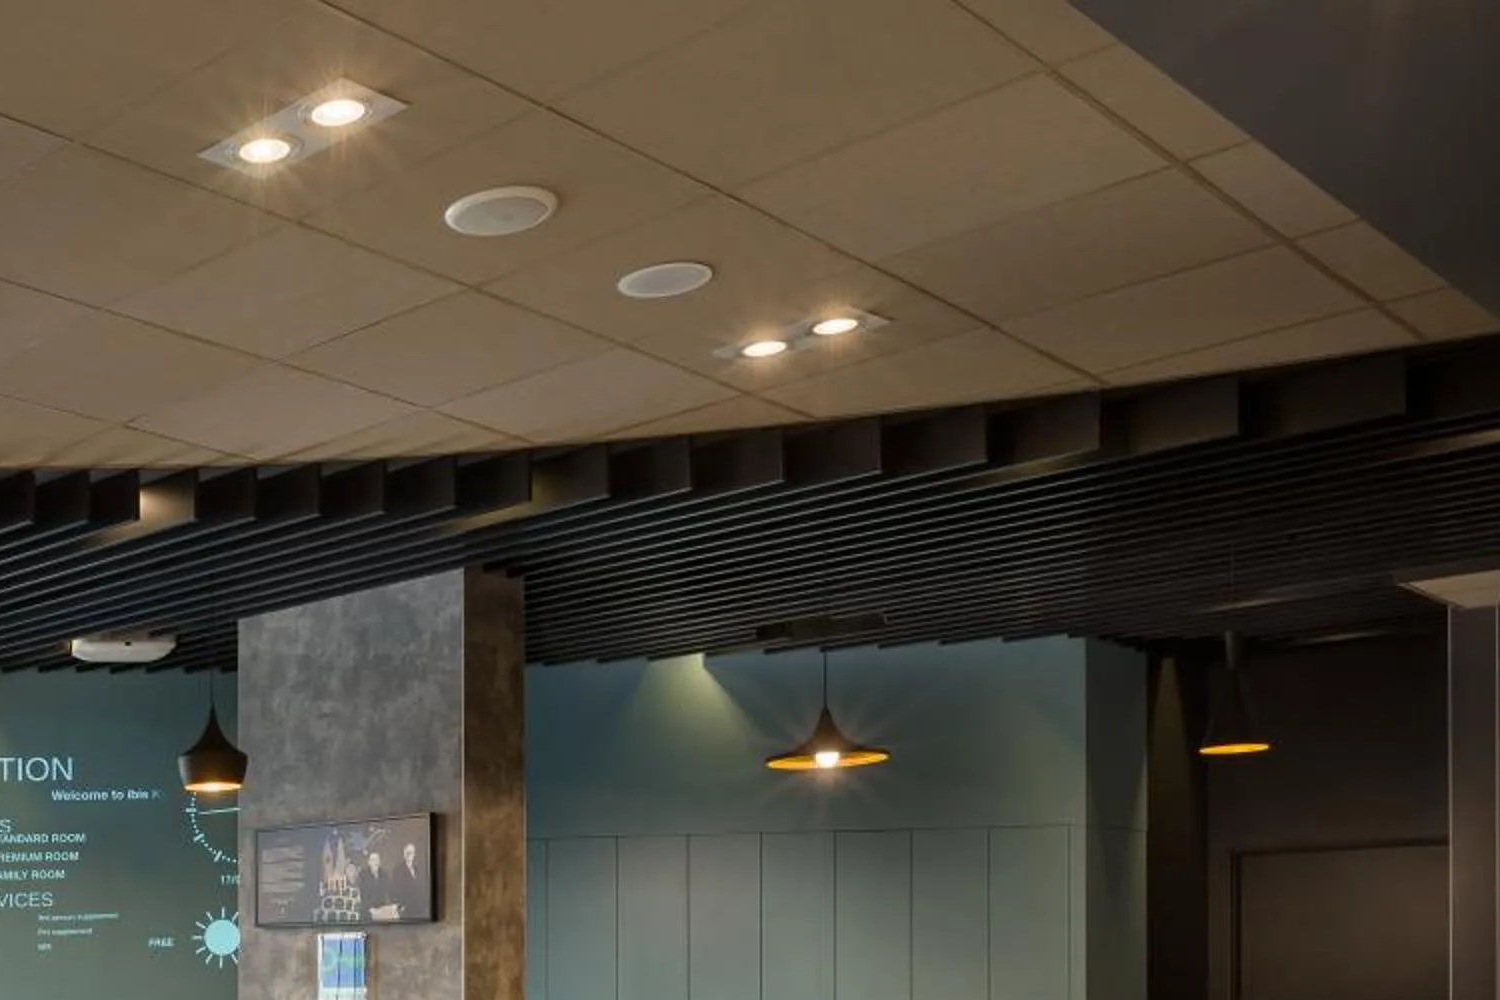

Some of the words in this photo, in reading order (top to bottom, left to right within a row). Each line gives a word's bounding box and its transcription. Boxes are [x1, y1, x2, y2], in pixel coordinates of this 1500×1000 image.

[51, 789, 109, 802] Welcome
[111, 789, 125, 801] to
[51, 833, 86, 843] ROOM
[45, 851, 79, 861] ROOM
[31, 869, 65, 880] ROOM
[148, 937, 175, 947] FREE
